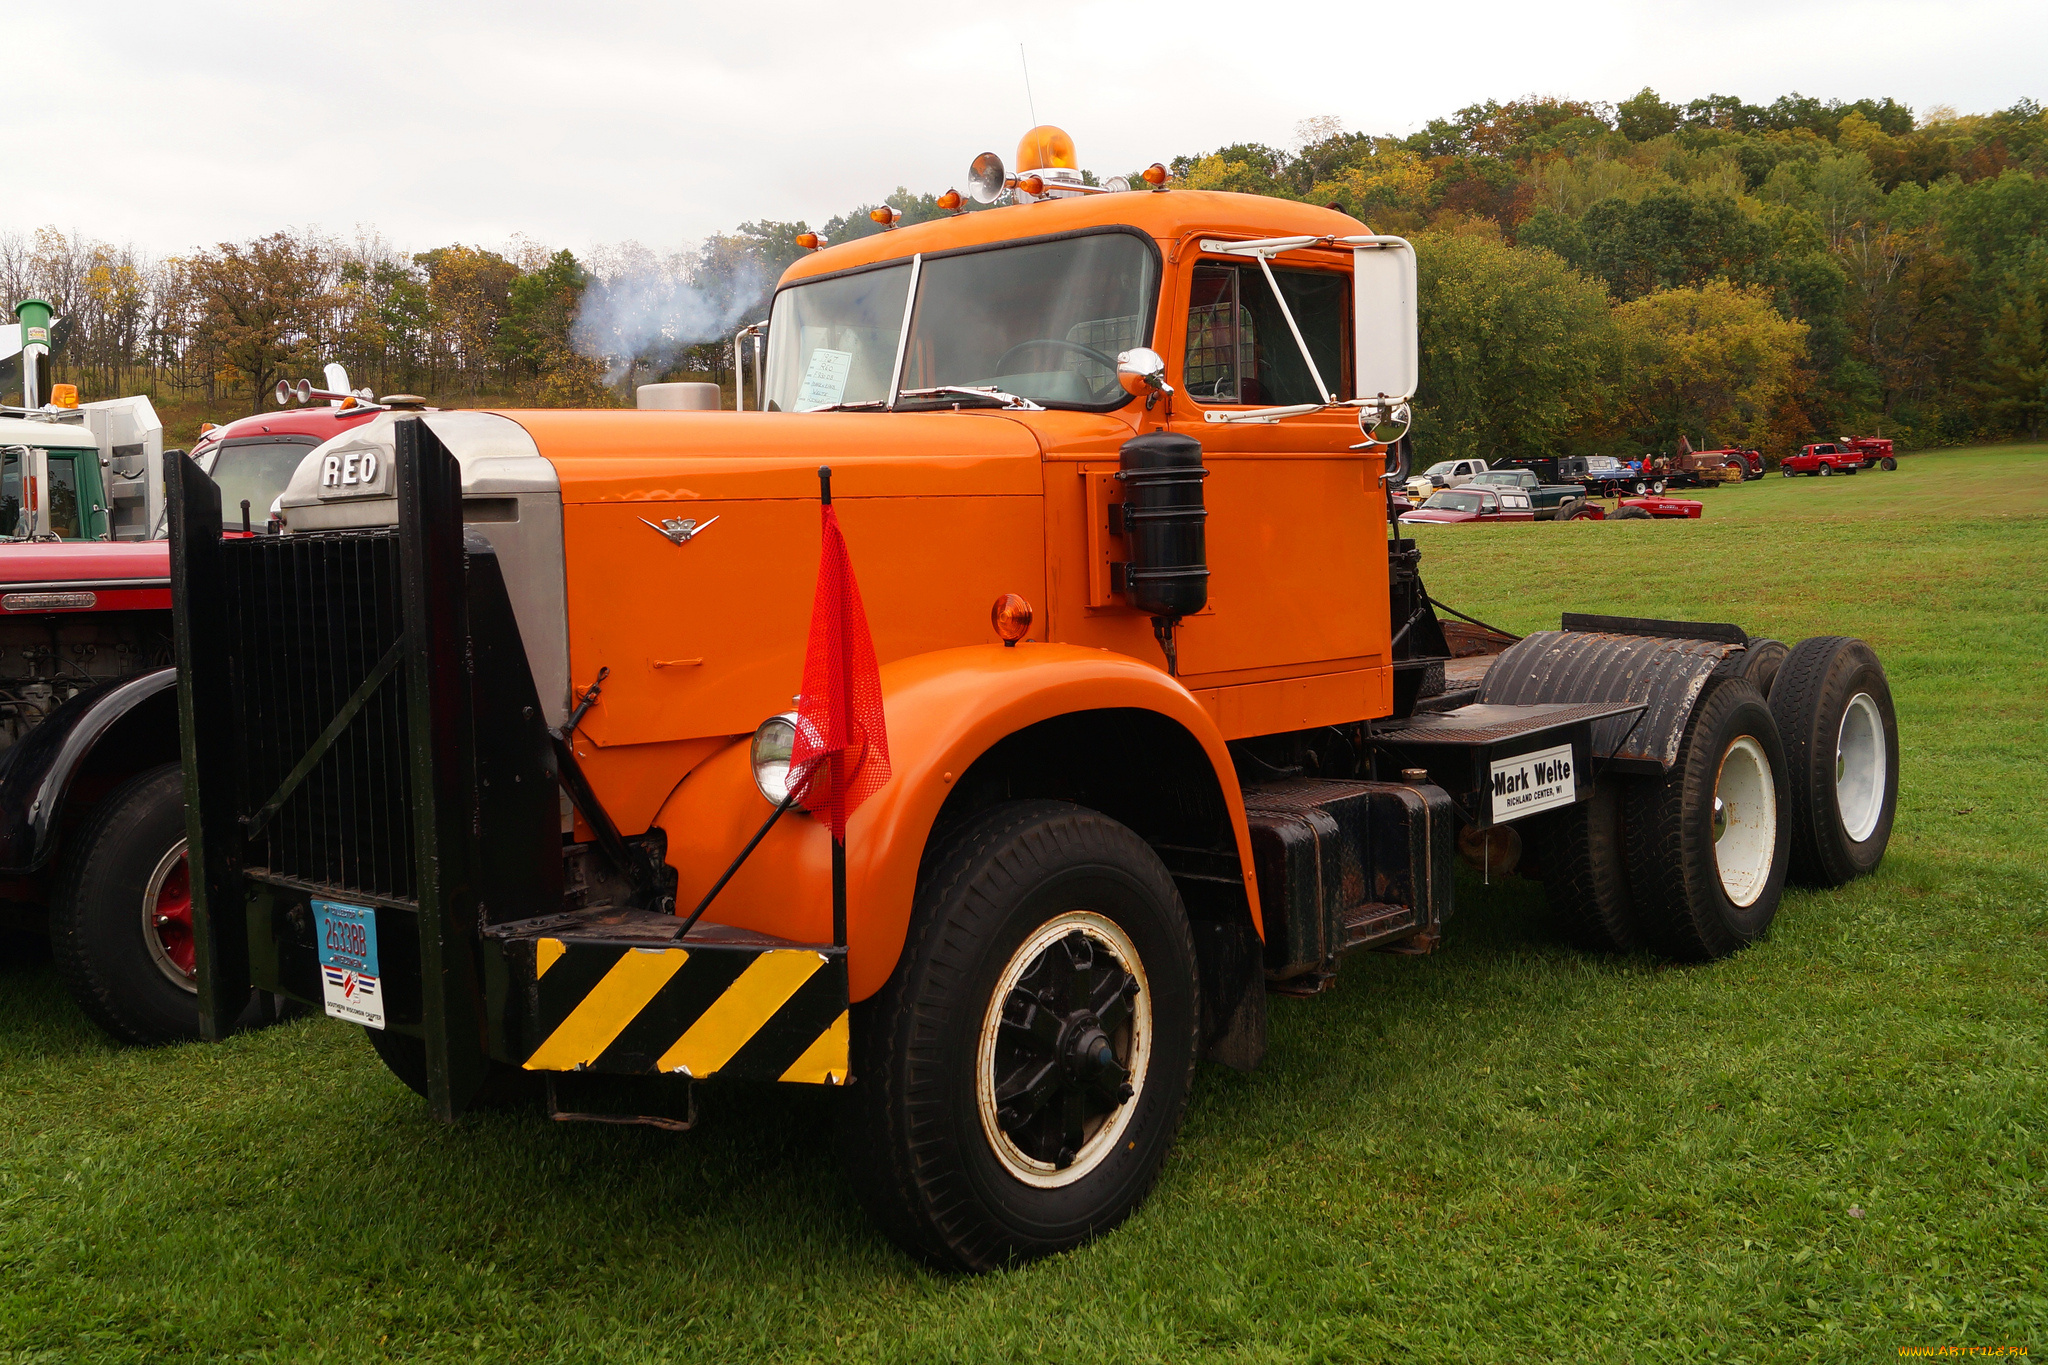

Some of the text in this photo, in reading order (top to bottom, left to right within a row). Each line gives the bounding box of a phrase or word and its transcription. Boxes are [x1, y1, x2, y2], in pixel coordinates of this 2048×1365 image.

[323, 453, 378, 487] REO
[8, 594, 92, 608] HENDRICKSON
[1494, 759, 1571, 797] Mark Welte
[1506, 785, 1563, 807] RICHLAND CENTER, WI
[324, 917, 367, 957] 26338B
